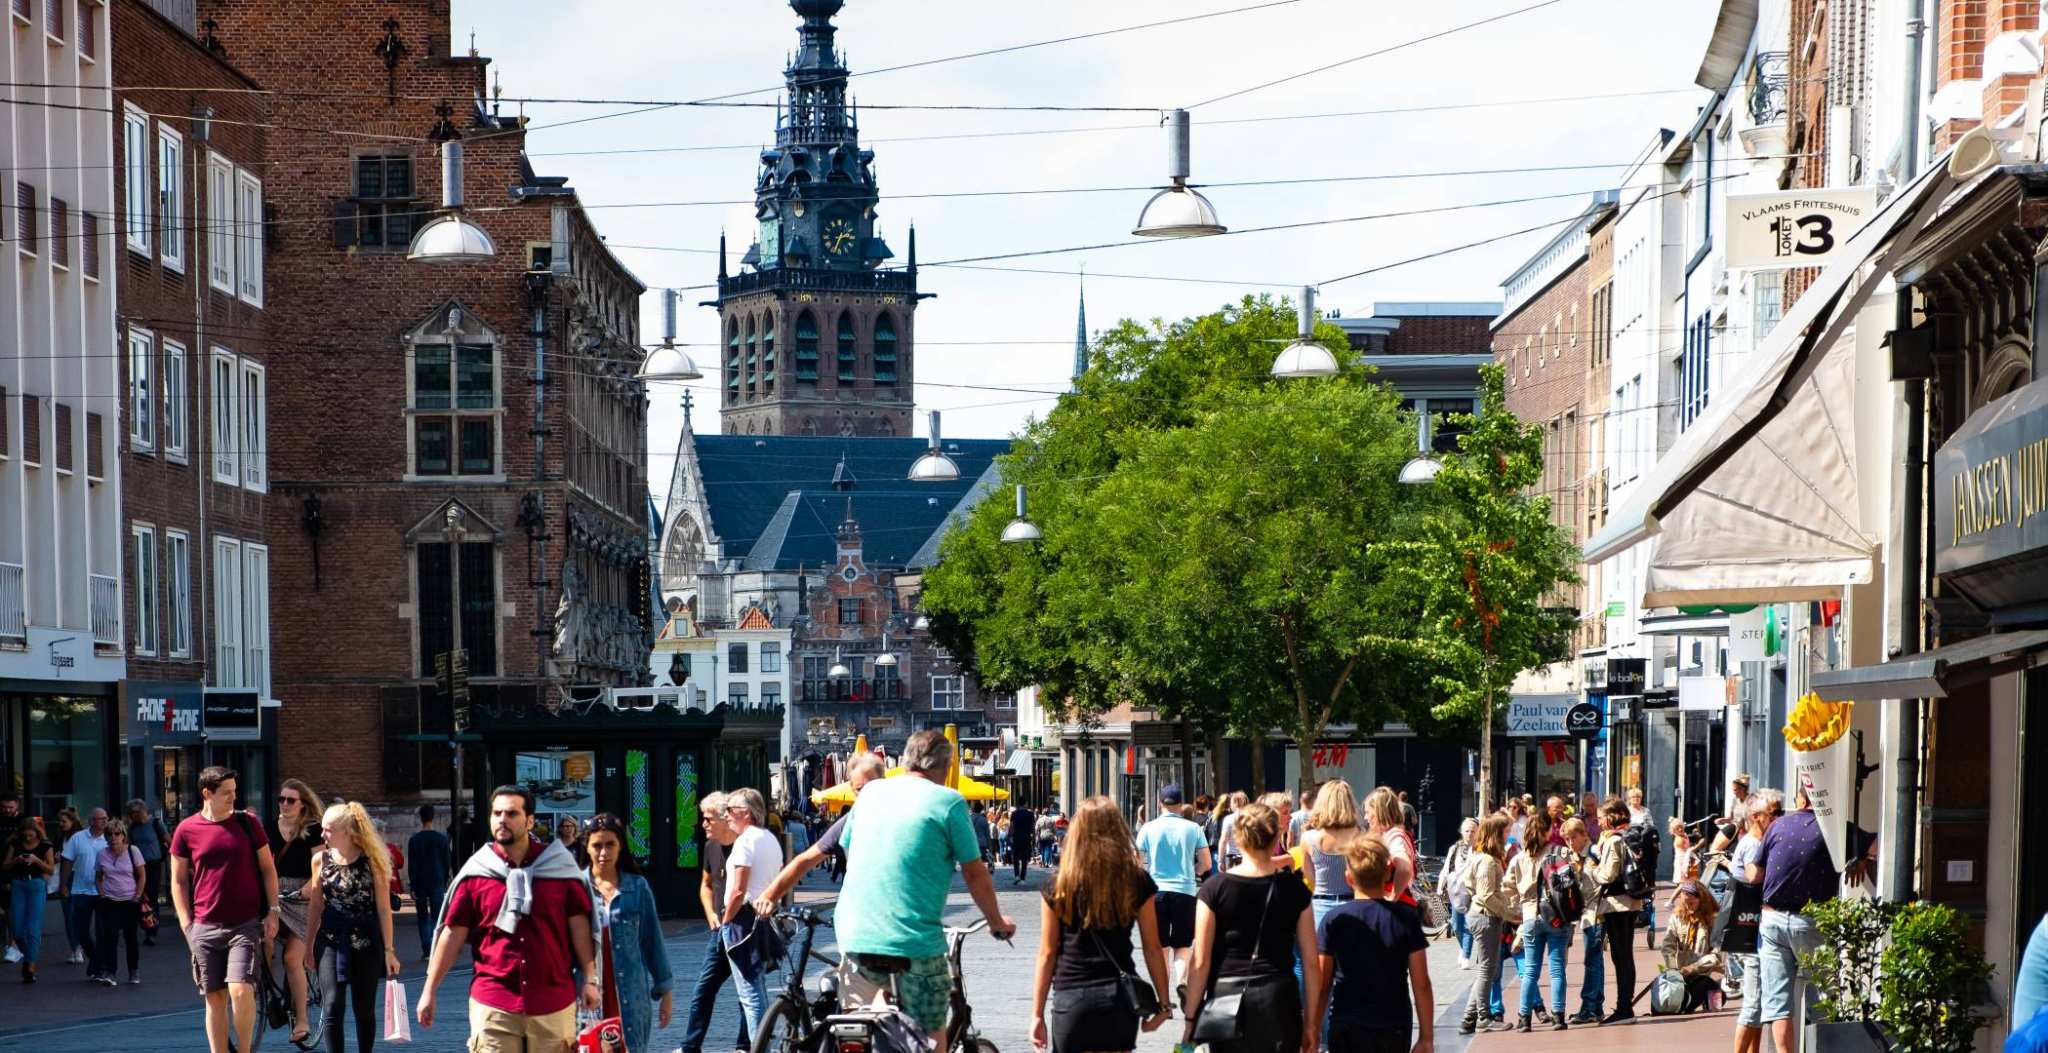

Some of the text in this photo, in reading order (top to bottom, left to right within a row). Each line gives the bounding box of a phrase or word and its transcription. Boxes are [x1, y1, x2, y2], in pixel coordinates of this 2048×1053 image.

[1742, 199, 1860, 221] VLAAMS FRITESHUIS
[1781, 216, 1792, 256] LOKET
[1952, 453, 2012, 547] JANSSEN
[137, 698, 166, 721] PHONE
[172, 709, 199, 732] PHONE
[1513, 703, 1568, 717] Paul van
